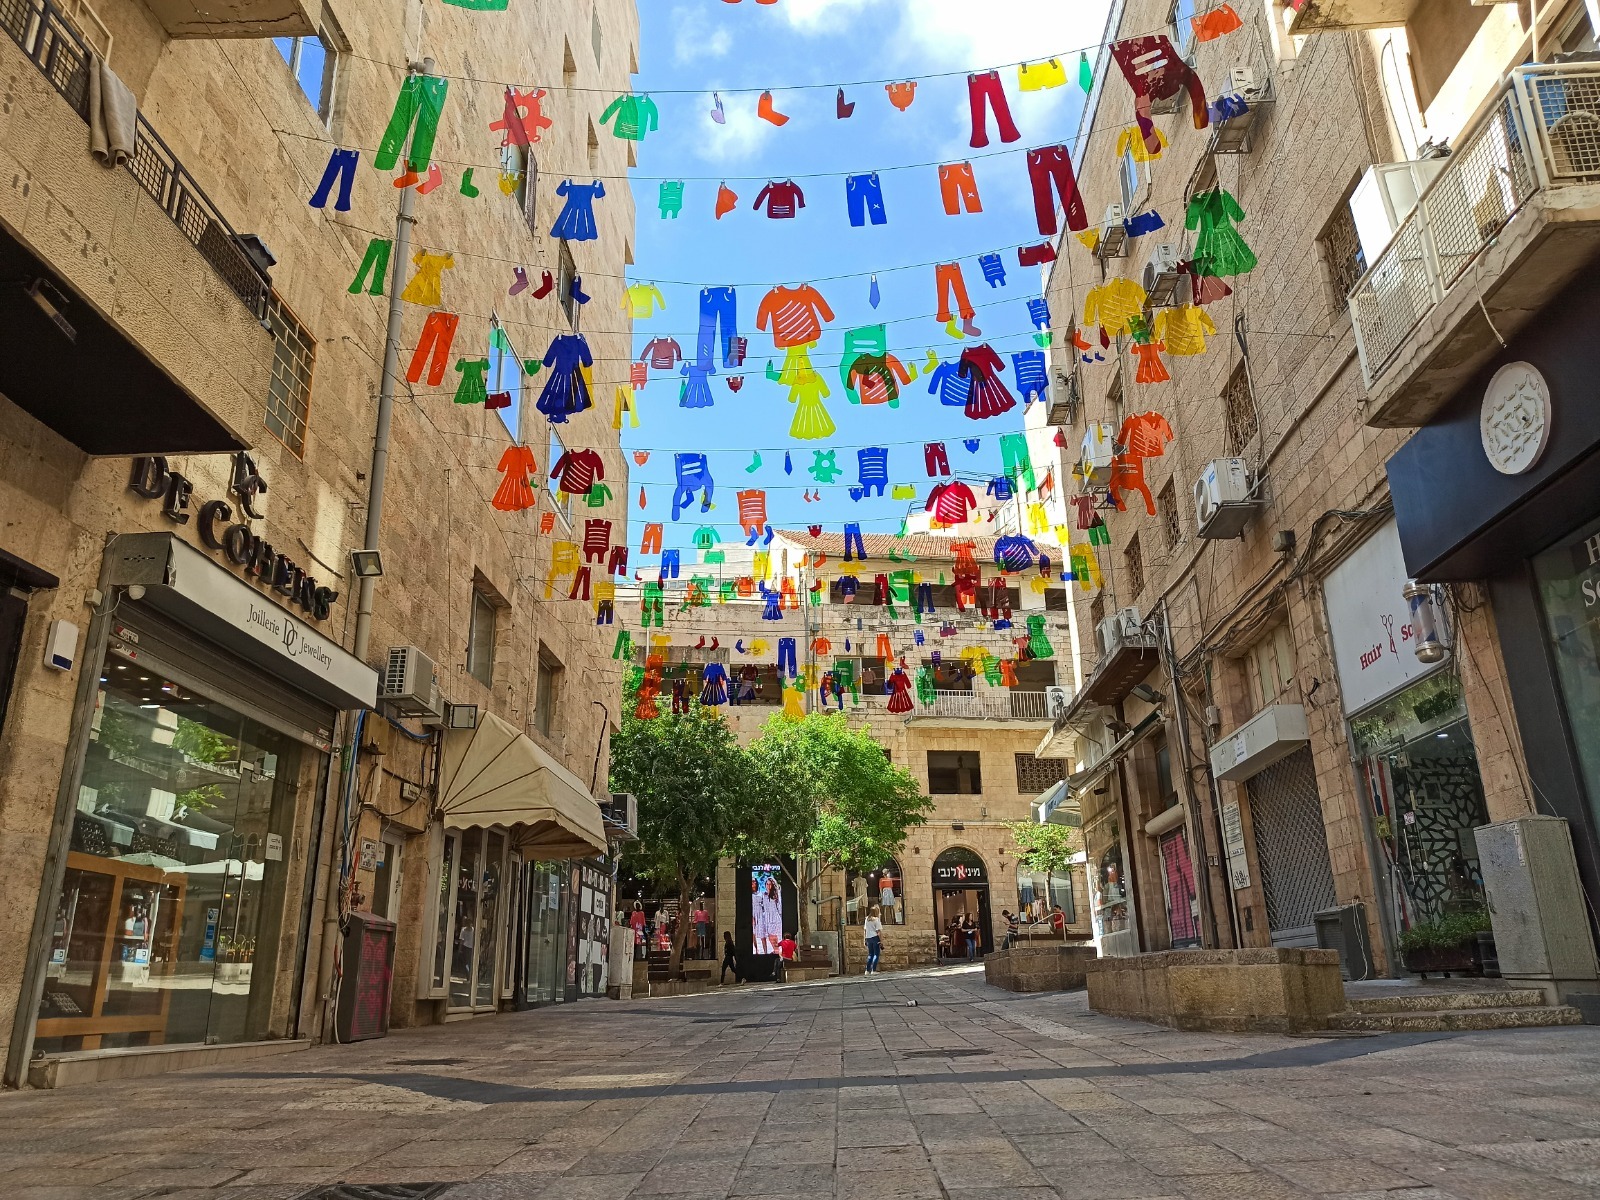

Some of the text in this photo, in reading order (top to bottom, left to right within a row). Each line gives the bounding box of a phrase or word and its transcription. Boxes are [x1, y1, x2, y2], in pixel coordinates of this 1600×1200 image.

[130, 456, 193, 525] DE
[247, 603, 280, 636] Joillerie
[299, 636, 332, 670] Jewellery
[1359, 642, 1382, 671] Hair
